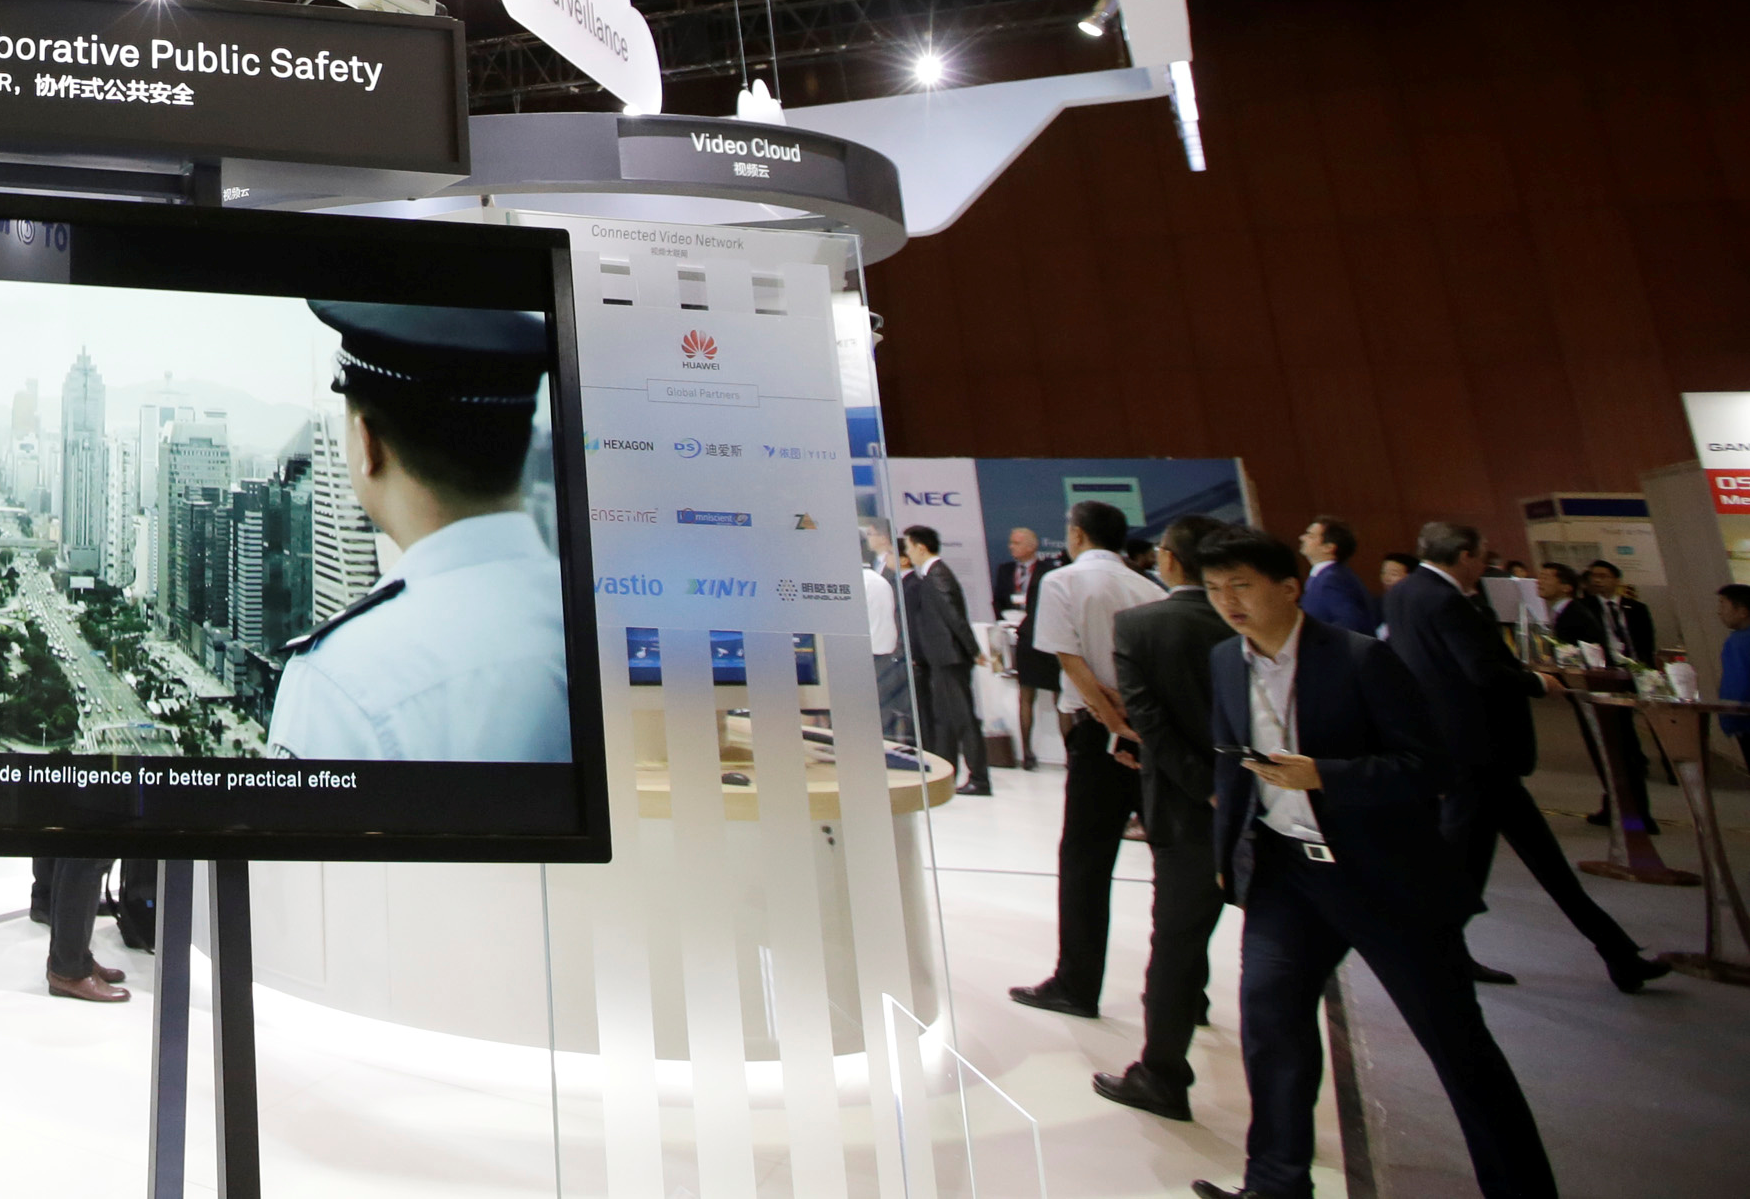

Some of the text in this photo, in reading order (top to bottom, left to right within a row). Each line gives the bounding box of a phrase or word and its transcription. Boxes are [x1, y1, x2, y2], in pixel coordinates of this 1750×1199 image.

[151, 39, 260, 77] Public
[270, 47, 383, 92] Safety
[690, 132, 802, 163] Video Cloud
[733, 161, 770, 180] 视频云
[591, 223, 744, 250] Connected Video Network
[682, 360, 720, 372] HUAWEI
[666, 385, 740, 401] Global Partners
[603, 439, 654, 451] HEXAGON
[674, 442, 695, 452] DS
[705, 443, 743, 457] 迪爱斯
[807, 450, 837, 460] YITU
[904, 491, 962, 507] NEC
[28, 766, 132, 788] intelligence
[138, 766, 163, 786] for
[169, 767, 222, 787] better
[226, 768, 303, 790] practical
[308, 770, 358, 789] effect
